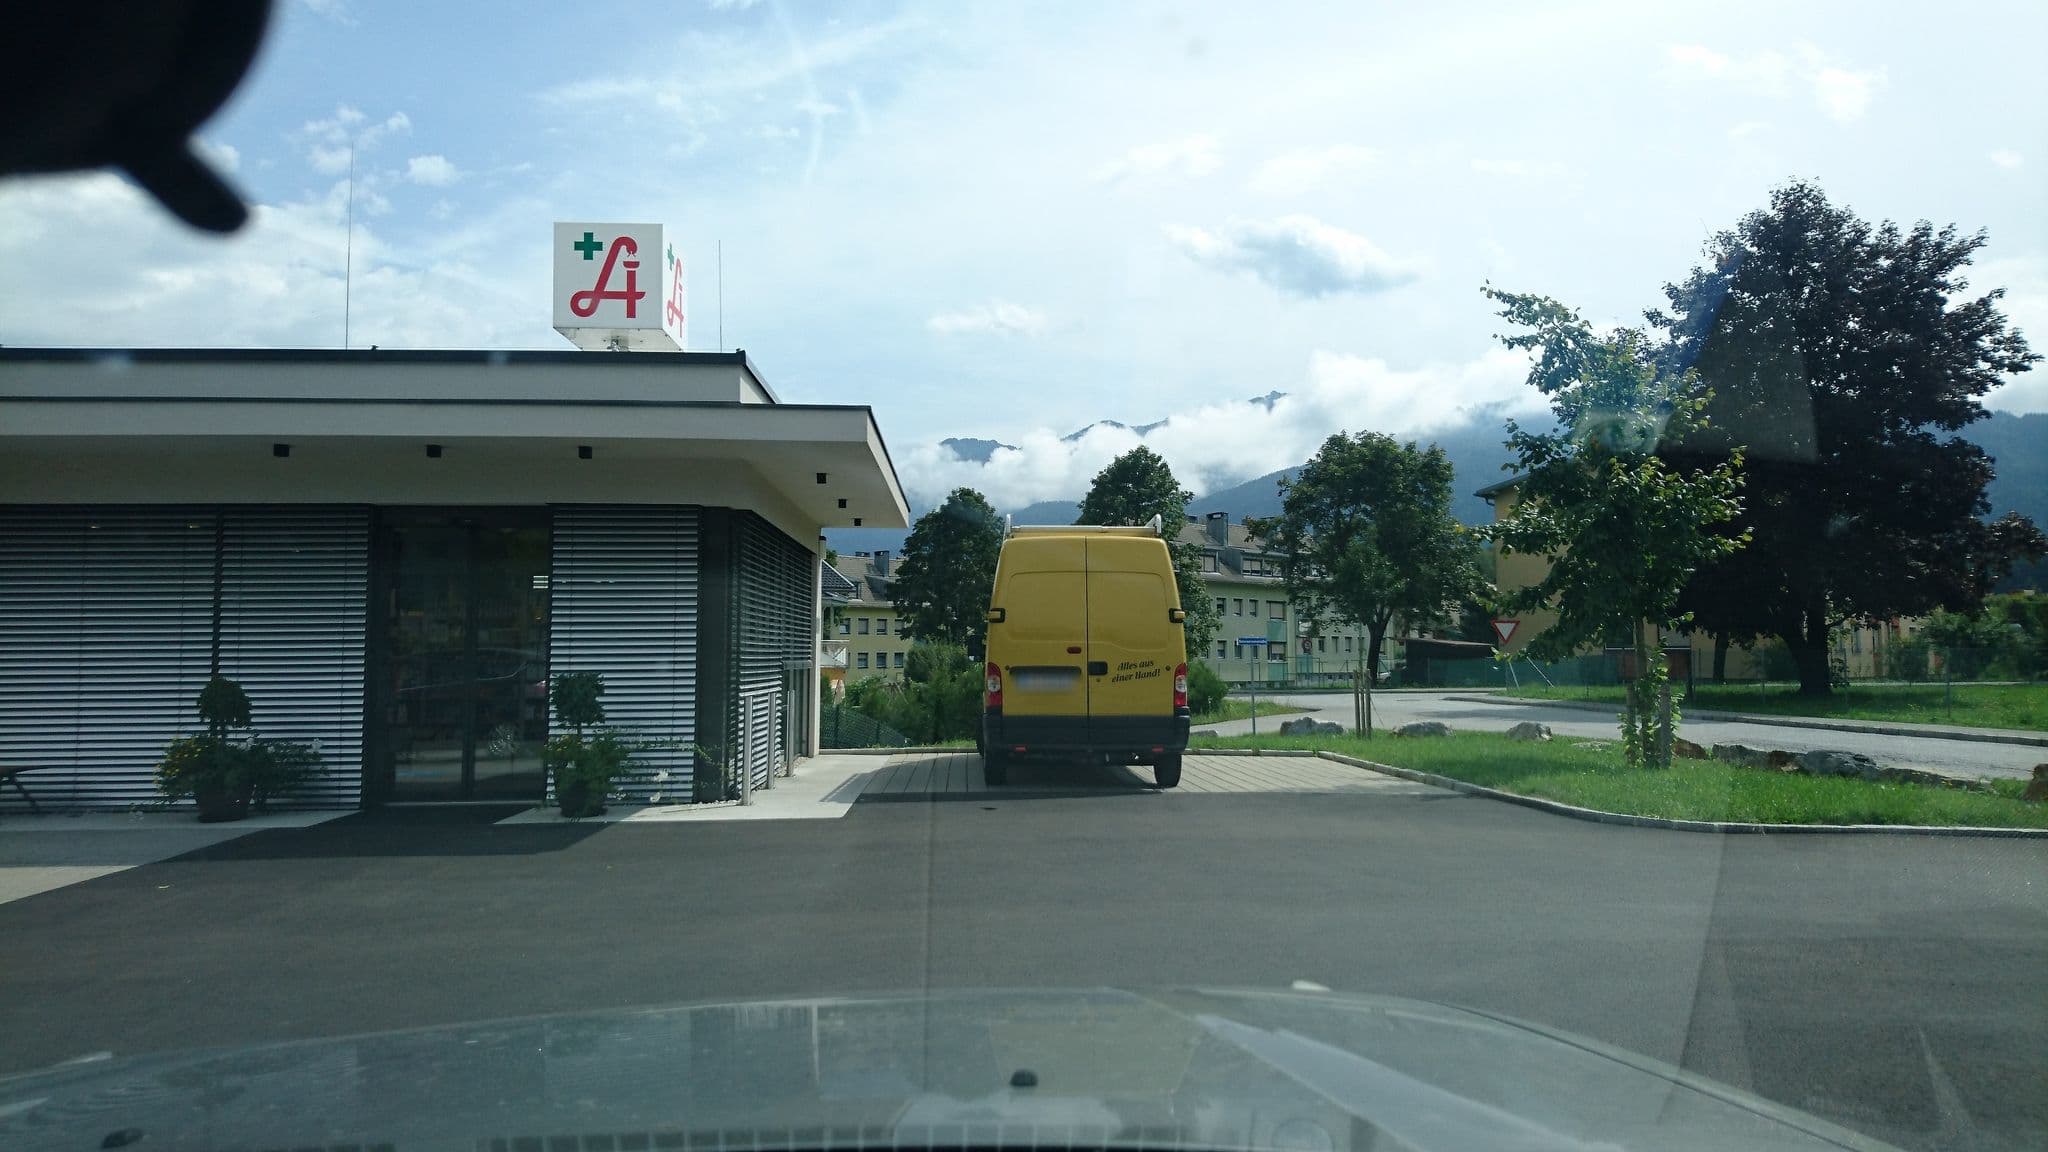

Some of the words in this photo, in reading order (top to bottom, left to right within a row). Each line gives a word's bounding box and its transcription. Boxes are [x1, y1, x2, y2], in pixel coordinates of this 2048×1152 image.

[1117, 661, 1138, 671] Alles
[1139, 660, 1154, 668] aus
[1111, 673, 1133, 683] einer
[1135, 668, 1161, 679] Hand!
